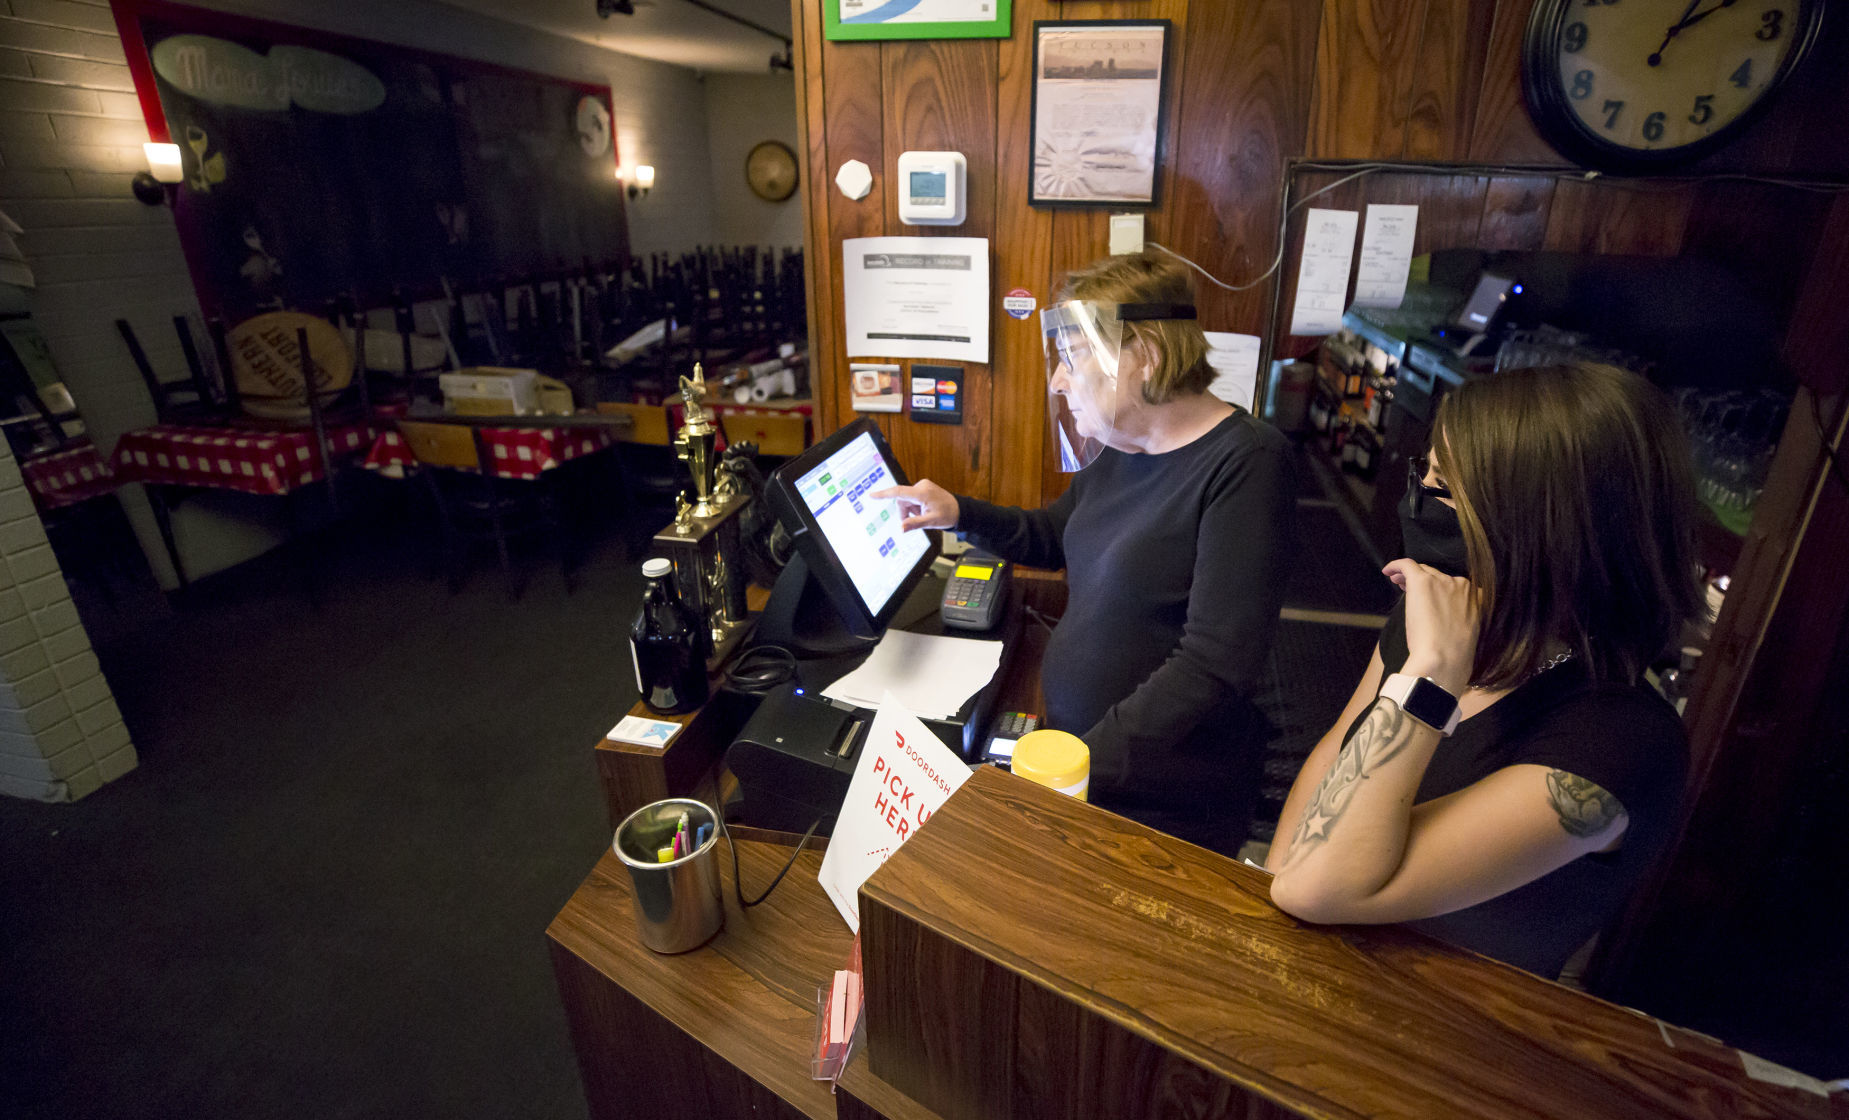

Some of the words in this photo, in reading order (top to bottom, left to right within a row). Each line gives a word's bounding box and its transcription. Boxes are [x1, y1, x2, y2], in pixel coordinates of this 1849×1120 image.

[1564, 22, 1588, 53] 9
[1756, 9, 1783, 41] 3
[1570, 70, 1594, 100] 8
[1728, 58, 1752, 88] 4
[1602, 100, 1624, 129] 7
[1689, 95, 1714, 125] 5
[1642, 112, 1665, 141] 6
[873, 755, 914, 811] PICK
[905, 745, 952, 795] DOORDASH
[874, 792, 916, 842] HER
